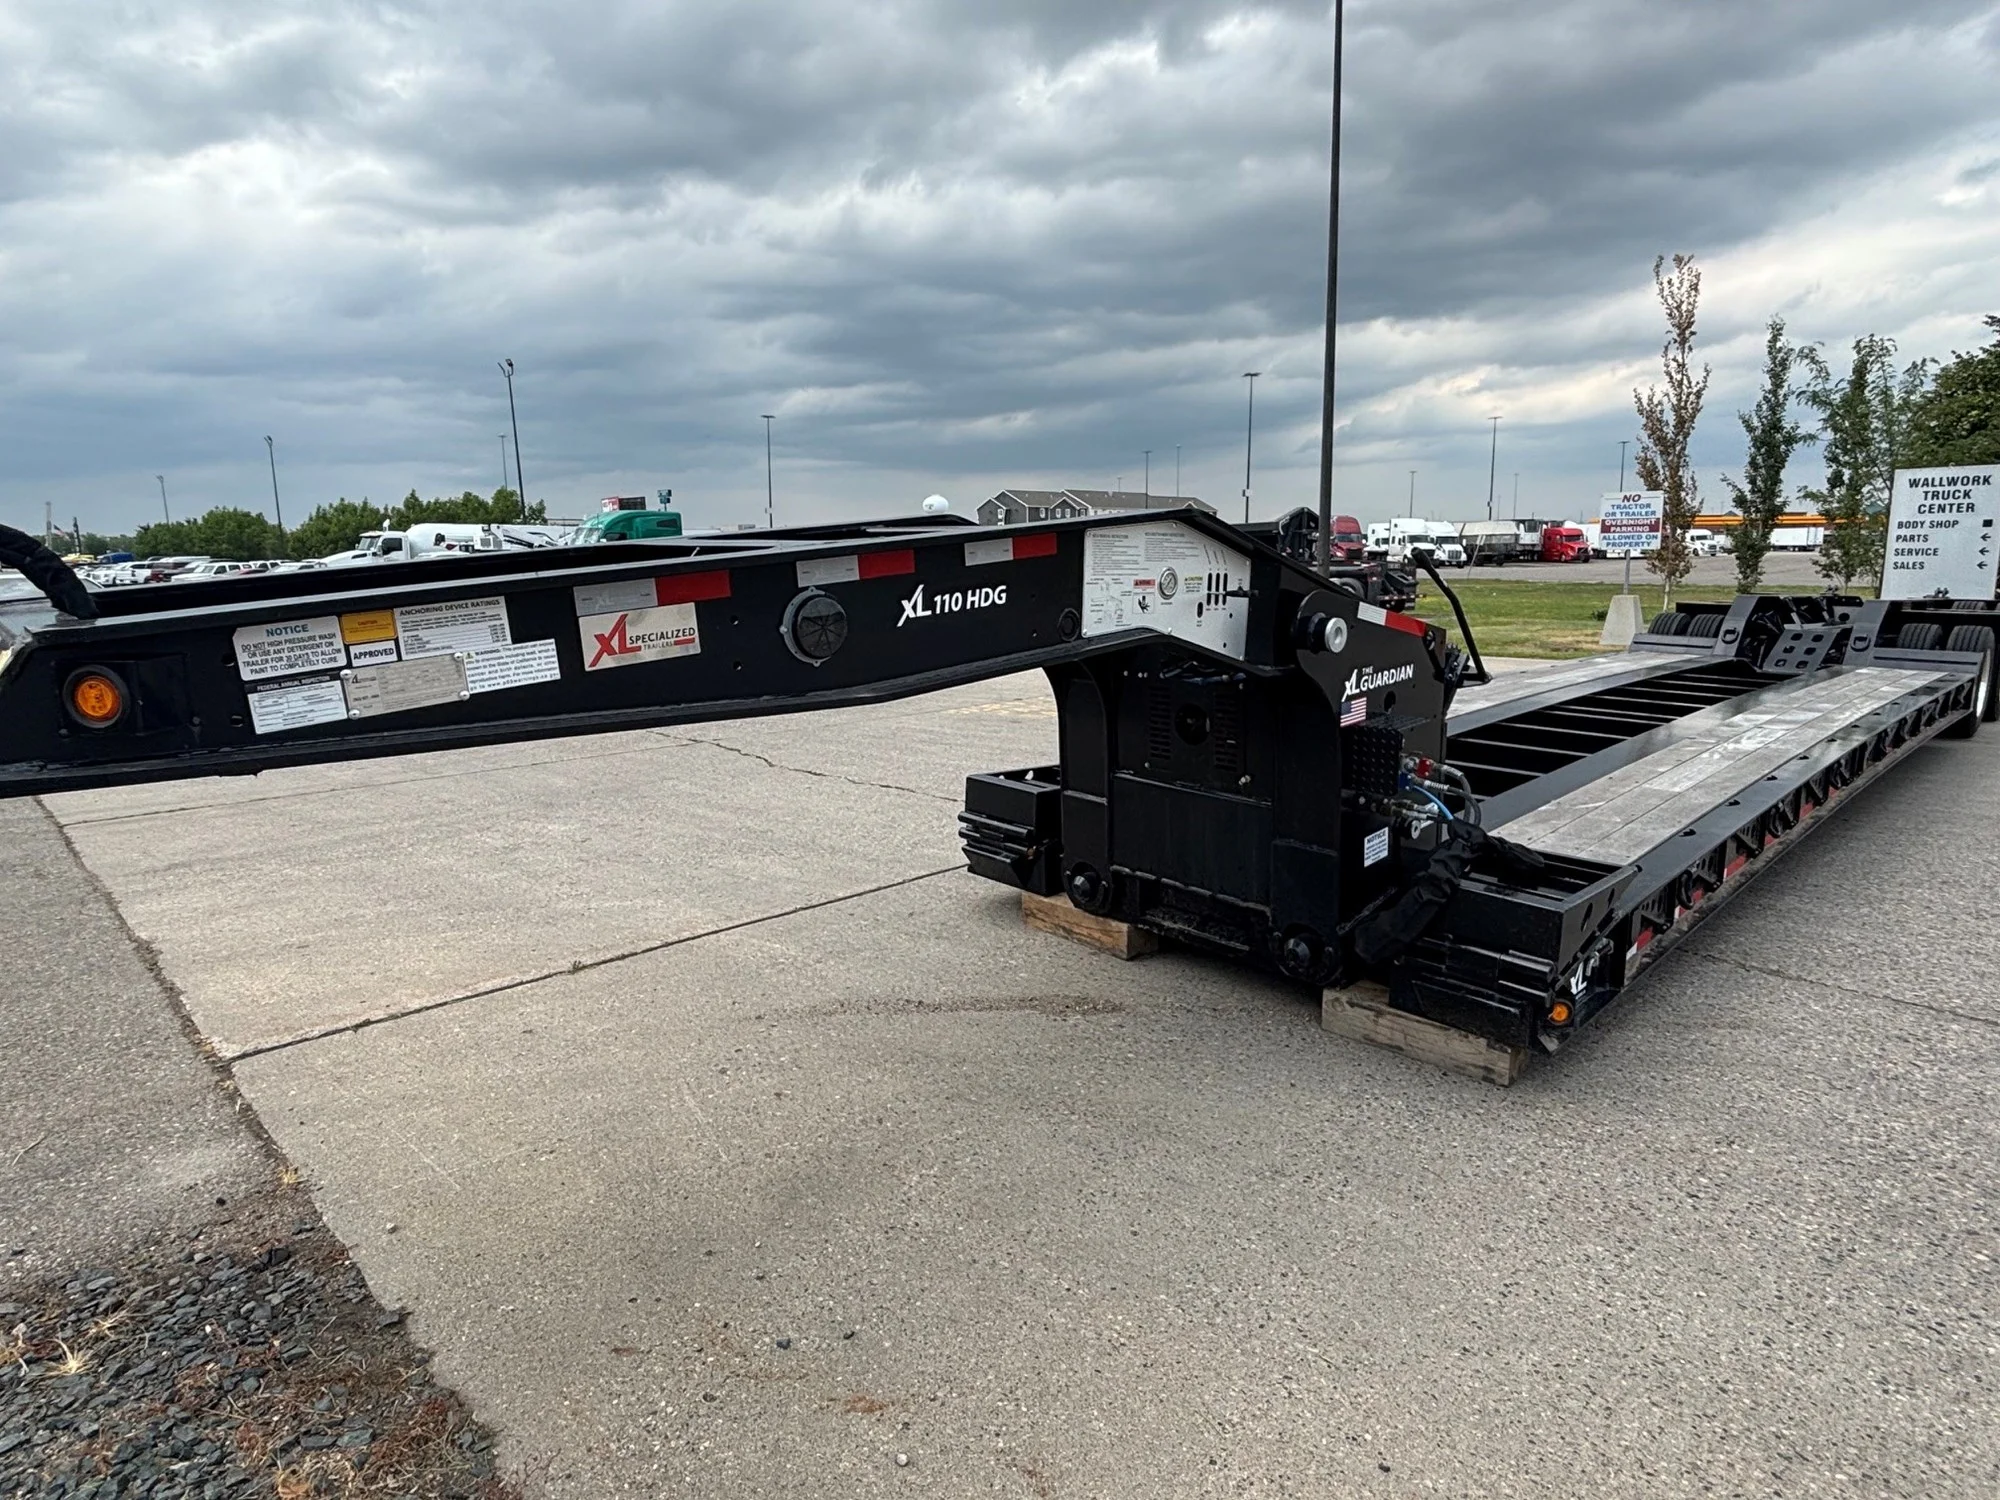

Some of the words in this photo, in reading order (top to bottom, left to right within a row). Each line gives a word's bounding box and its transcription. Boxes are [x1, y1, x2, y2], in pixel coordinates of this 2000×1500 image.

[1908, 475, 1992, 488] WALLWORK
[1622, 494, 1641, 503] NO
[1922, 489, 1972, 501] TRUCK
[1918, 502, 1975, 514] CENTER
[1898, 520, 1926, 529] BODY
[1928, 520, 1959, 529] SHOP
[1896, 534, 1929, 542] PARTS
[1894, 548, 1939, 556] SERVICE
[1893, 561, 1924, 570] SALES
[400, 607, 443, 616] ANCHORING
[471, 600, 500, 608] RATINGS
[896, 584, 932, 627] XL
[934, 591, 962, 614] 110
[966, 585, 1007, 610] HDG
[266, 624, 310, 637] NOTICE
[241, 643, 251, 652] DO
[253, 641, 266, 650] NOT
[268, 639, 283, 648] HIGH
[284, 635, 316, 645] PRESSURE
[318, 632, 336, 641] WASH
[588, 613, 642, 668] XL
[629, 627, 696, 645] SPECIALIZED
[644, 640, 674, 650] TRAILERS
[248, 651, 258, 659] OR
[273, 648, 286, 656] ANY
[287, 643, 323, 654] DETERGENT
[353, 648, 394, 660] APPROVED
[242, 658, 270, 668] TRAILER
[271, 656, 284, 664] FOR
[294, 652, 310, 662] DAYS
[312, 650, 320, 658] TO
[320, 648, 342, 657] ALLOW
[250, 667, 268, 675] PAINT
[280, 660, 320, 670] COMPLETELY
[321, 656, 338, 664] CURE
[1362, 666, 1373, 675] THE
[256, 684, 280, 692] FEDERAL
[281, 680, 301, 688] ANNUAL
[1341, 669, 1360, 702] XL
[1360, 664, 1414, 691] GUARDIAN
[1366, 830, 1386, 844] NOTICE
